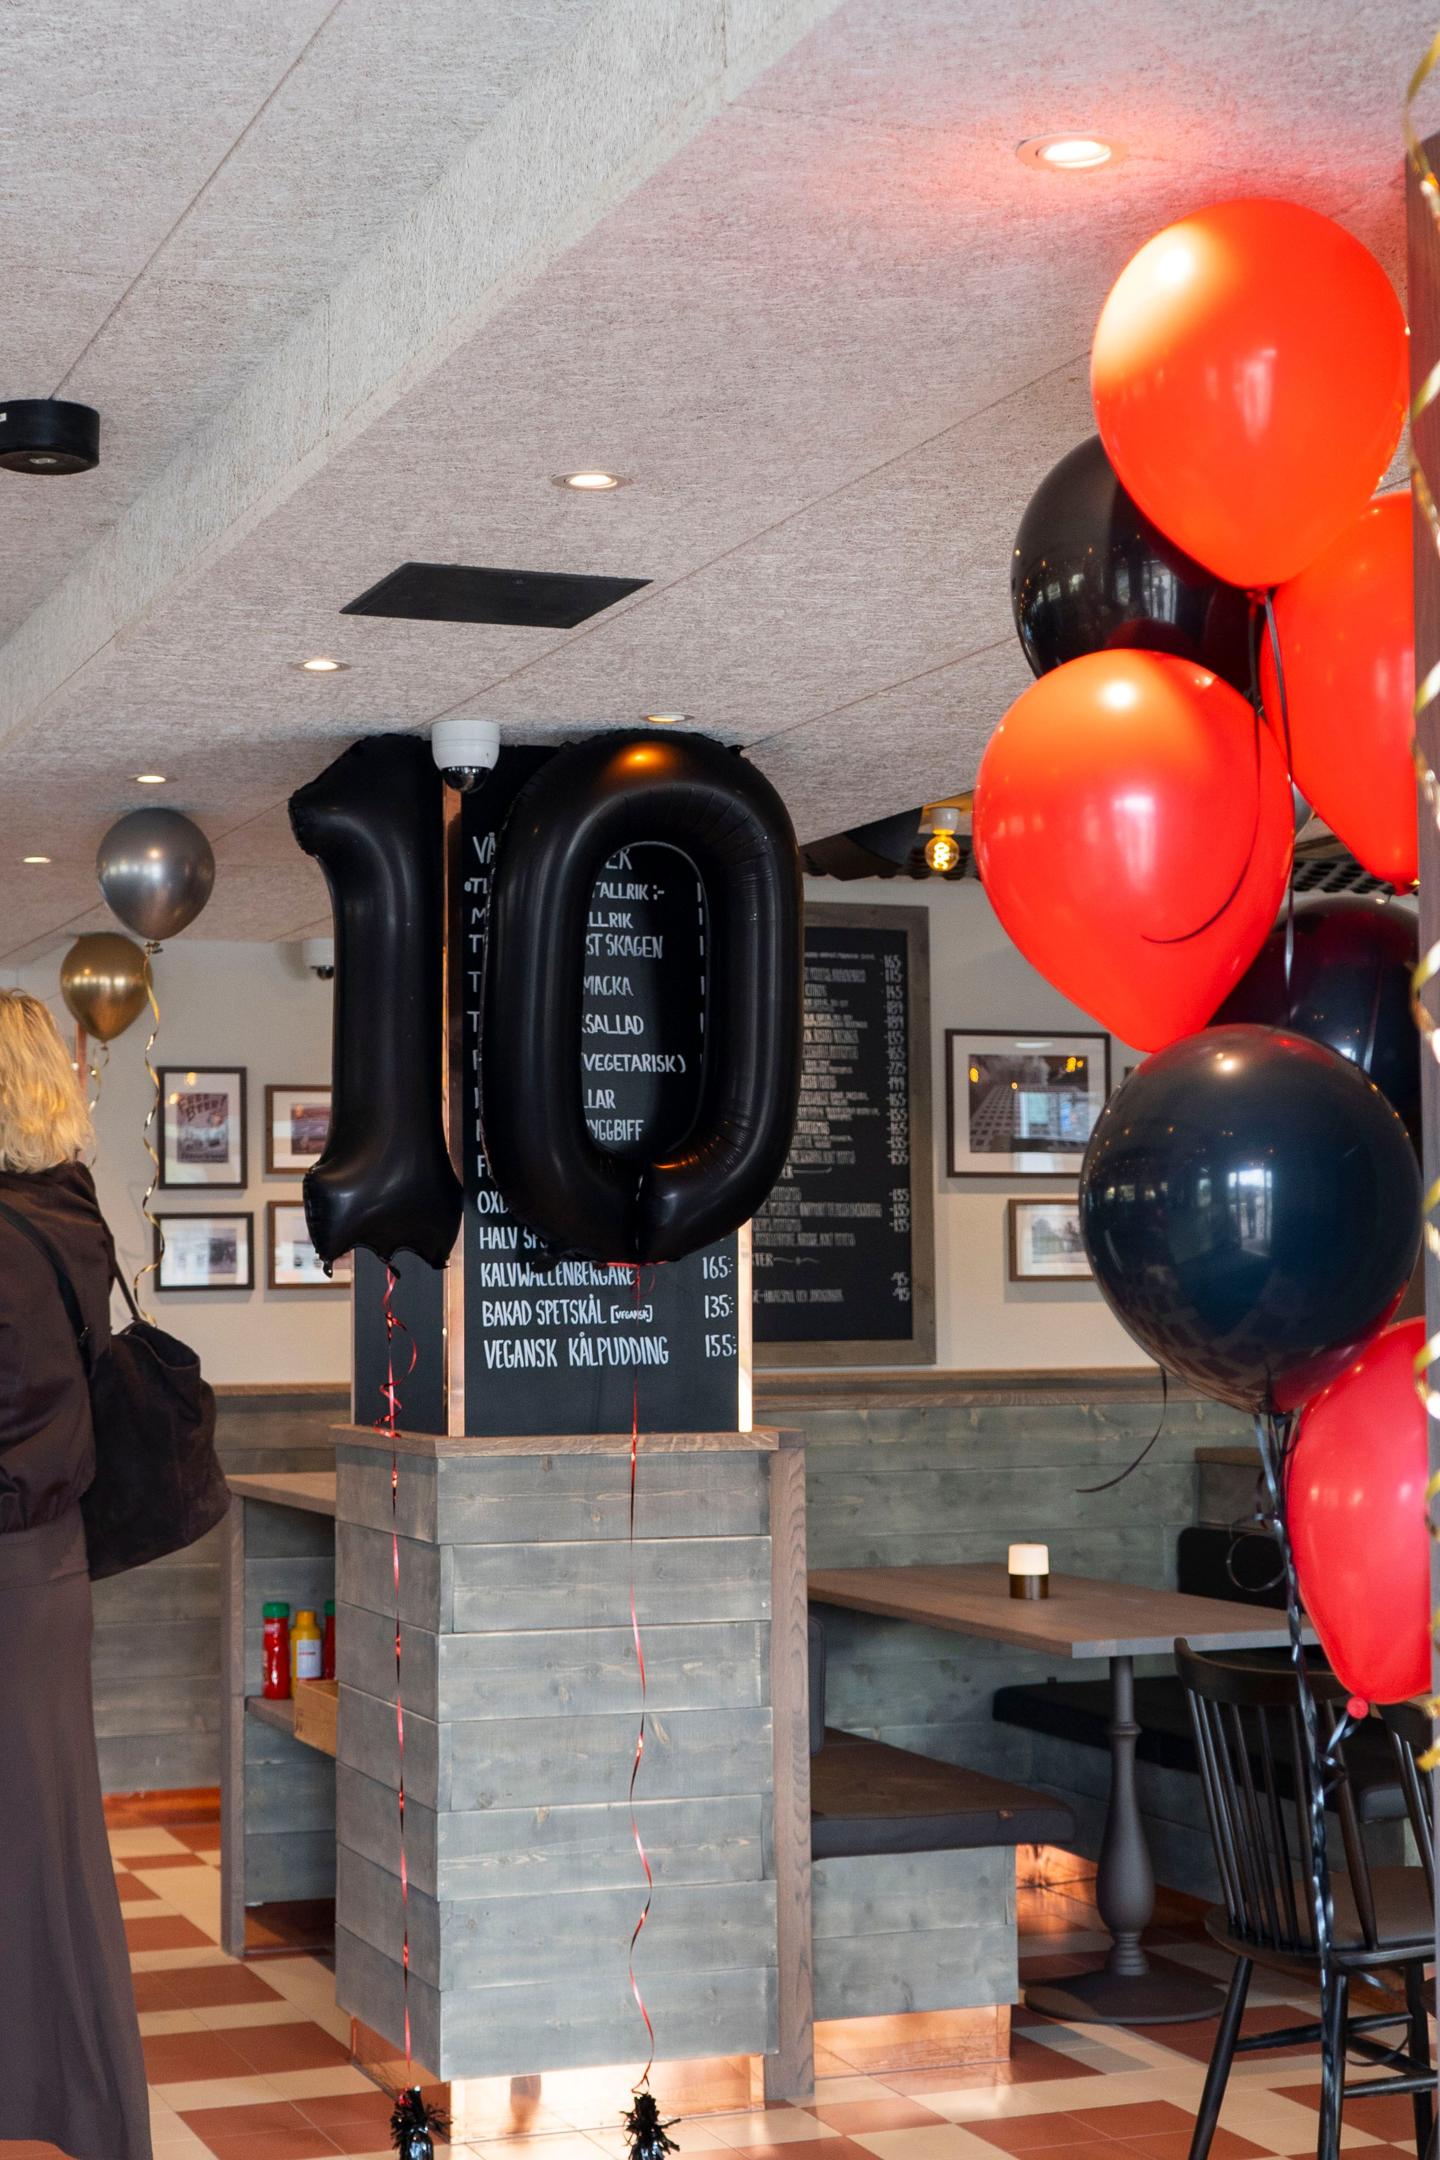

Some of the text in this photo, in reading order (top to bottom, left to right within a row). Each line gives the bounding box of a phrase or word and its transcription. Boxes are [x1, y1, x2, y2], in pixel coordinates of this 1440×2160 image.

[605, 933, 664, 960] SKAGEN
[581, 1013, 645, 1036] SALLAD
[581, 1052, 687, 1074] VEGETARISK)
[585, 1118, 646, 1142] YGGBIFF
[479, 1226, 518, 1251] HALV
[482, 1300, 532, 1327] BAKAD
[536, 1293, 607, 1326] SPETSKÅL
[484, 1337, 559, 1370] VEGANSK
[568, 1331, 670, 1367] KÅLPUDDING
